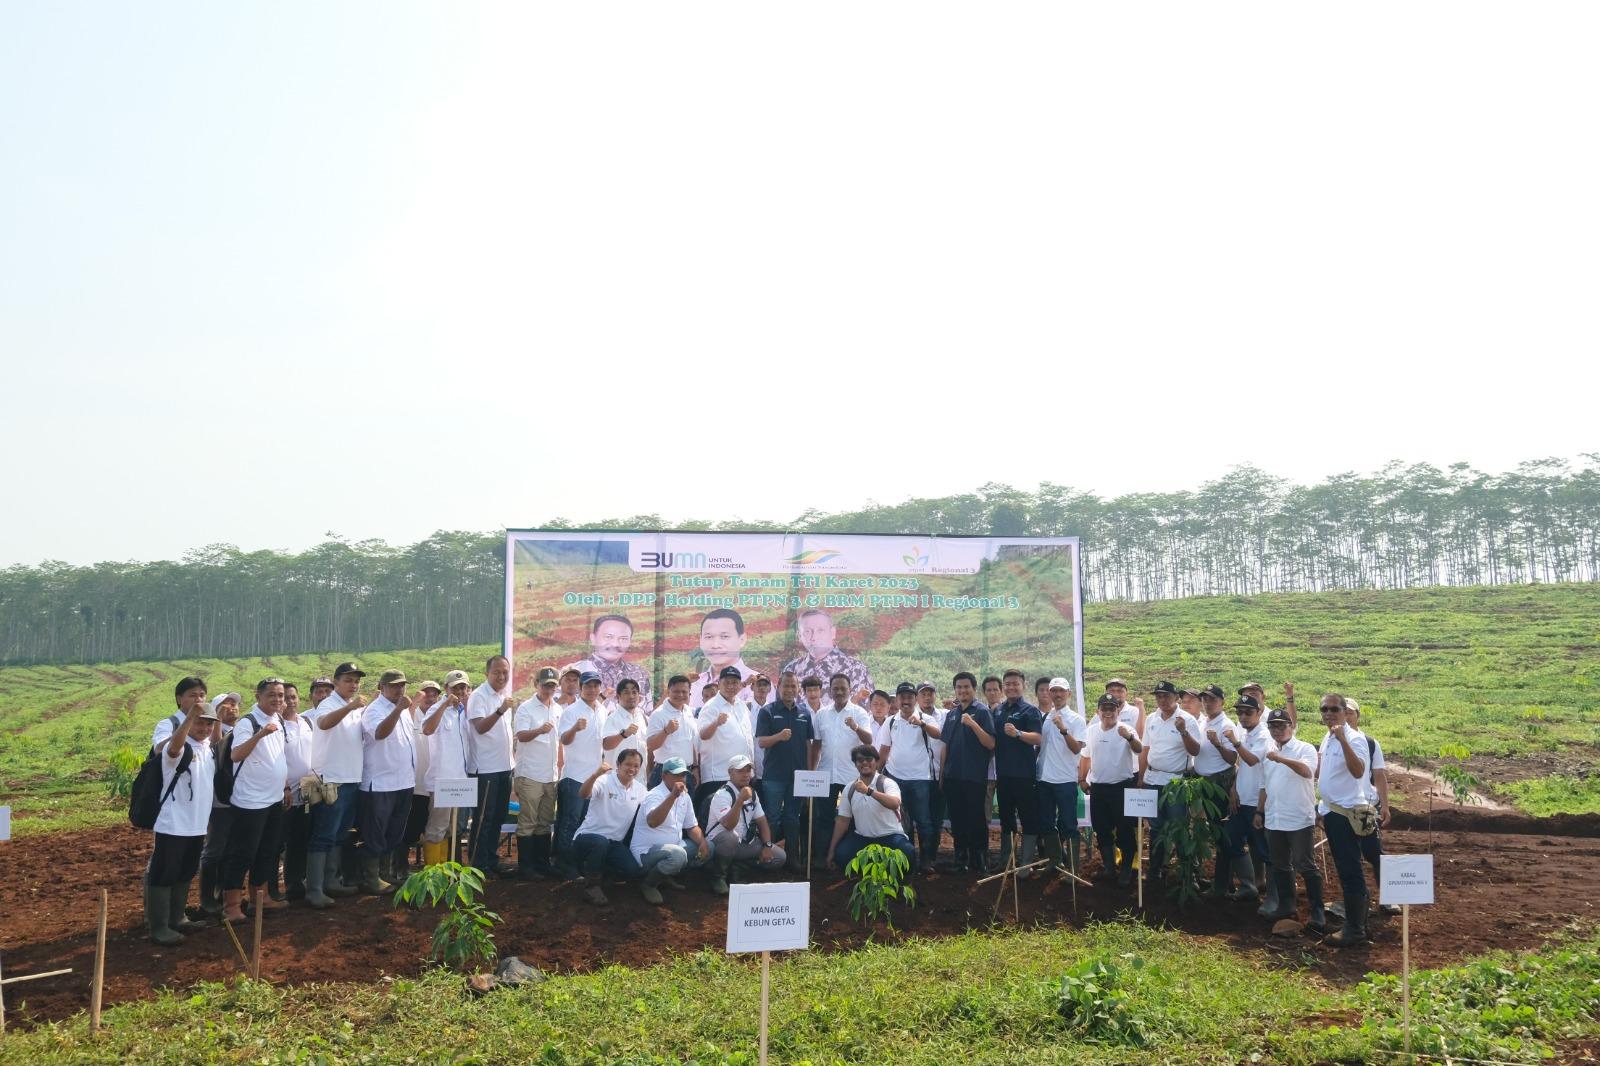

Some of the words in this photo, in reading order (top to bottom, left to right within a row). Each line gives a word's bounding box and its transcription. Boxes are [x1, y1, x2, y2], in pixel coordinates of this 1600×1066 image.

[670, 575, 724, 589] Tutup
[728, 575, 787, 588] Tanam
[825, 575, 875, 588] Karet
[879, 578, 920, 590] 2023
[563, 591, 604, 606] Oleh
[618, 592, 657, 607] DPP
[664, 592, 734, 609] Holding
[737, 593, 787, 608] PTPN
[790, 595, 802, 609] 3
[805, 593, 820, 608] &
[824, 593, 865, 608] BRM
[868, 594, 918, 608] PTPN
[931, 594, 1005, 611] Regional
[1007, 596, 1020, 609] 3
[750, 905, 790, 915] MANAGER
[744, 918, 770, 928] KEBUN
[771, 917, 796, 927] GETAS
